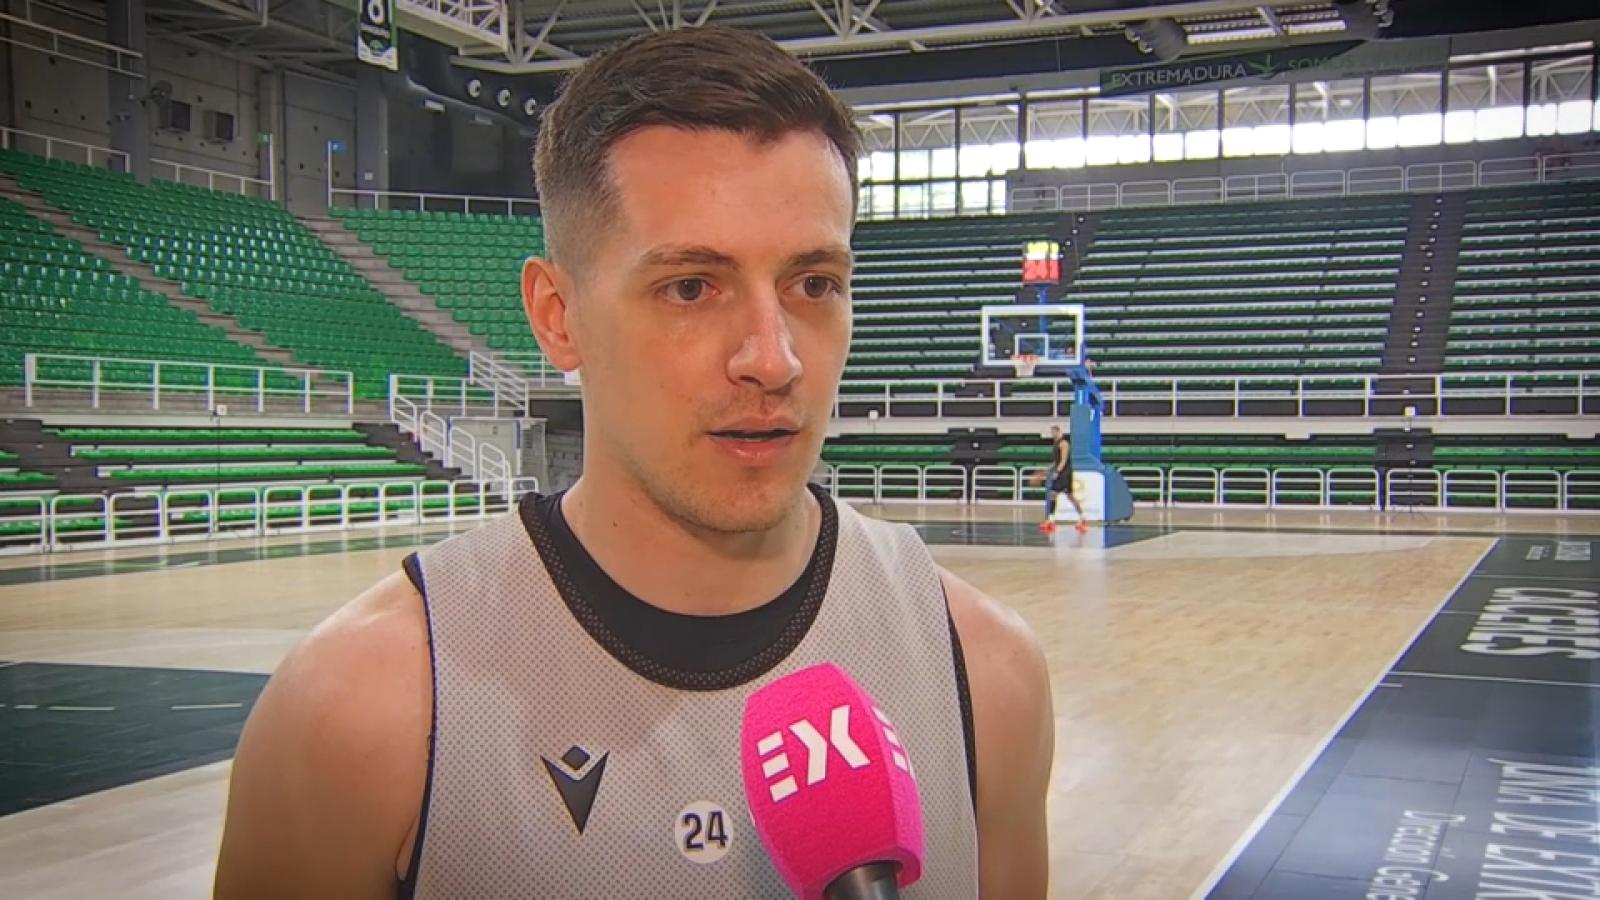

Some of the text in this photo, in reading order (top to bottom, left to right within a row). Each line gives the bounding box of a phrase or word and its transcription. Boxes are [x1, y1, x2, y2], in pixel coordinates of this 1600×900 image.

[1111, 63, 1247, 87] EXTREMADURA
[757, 704, 871, 803] EX
[682, 809, 729, 850] 24
[1490, 811, 1600, 843] DE
